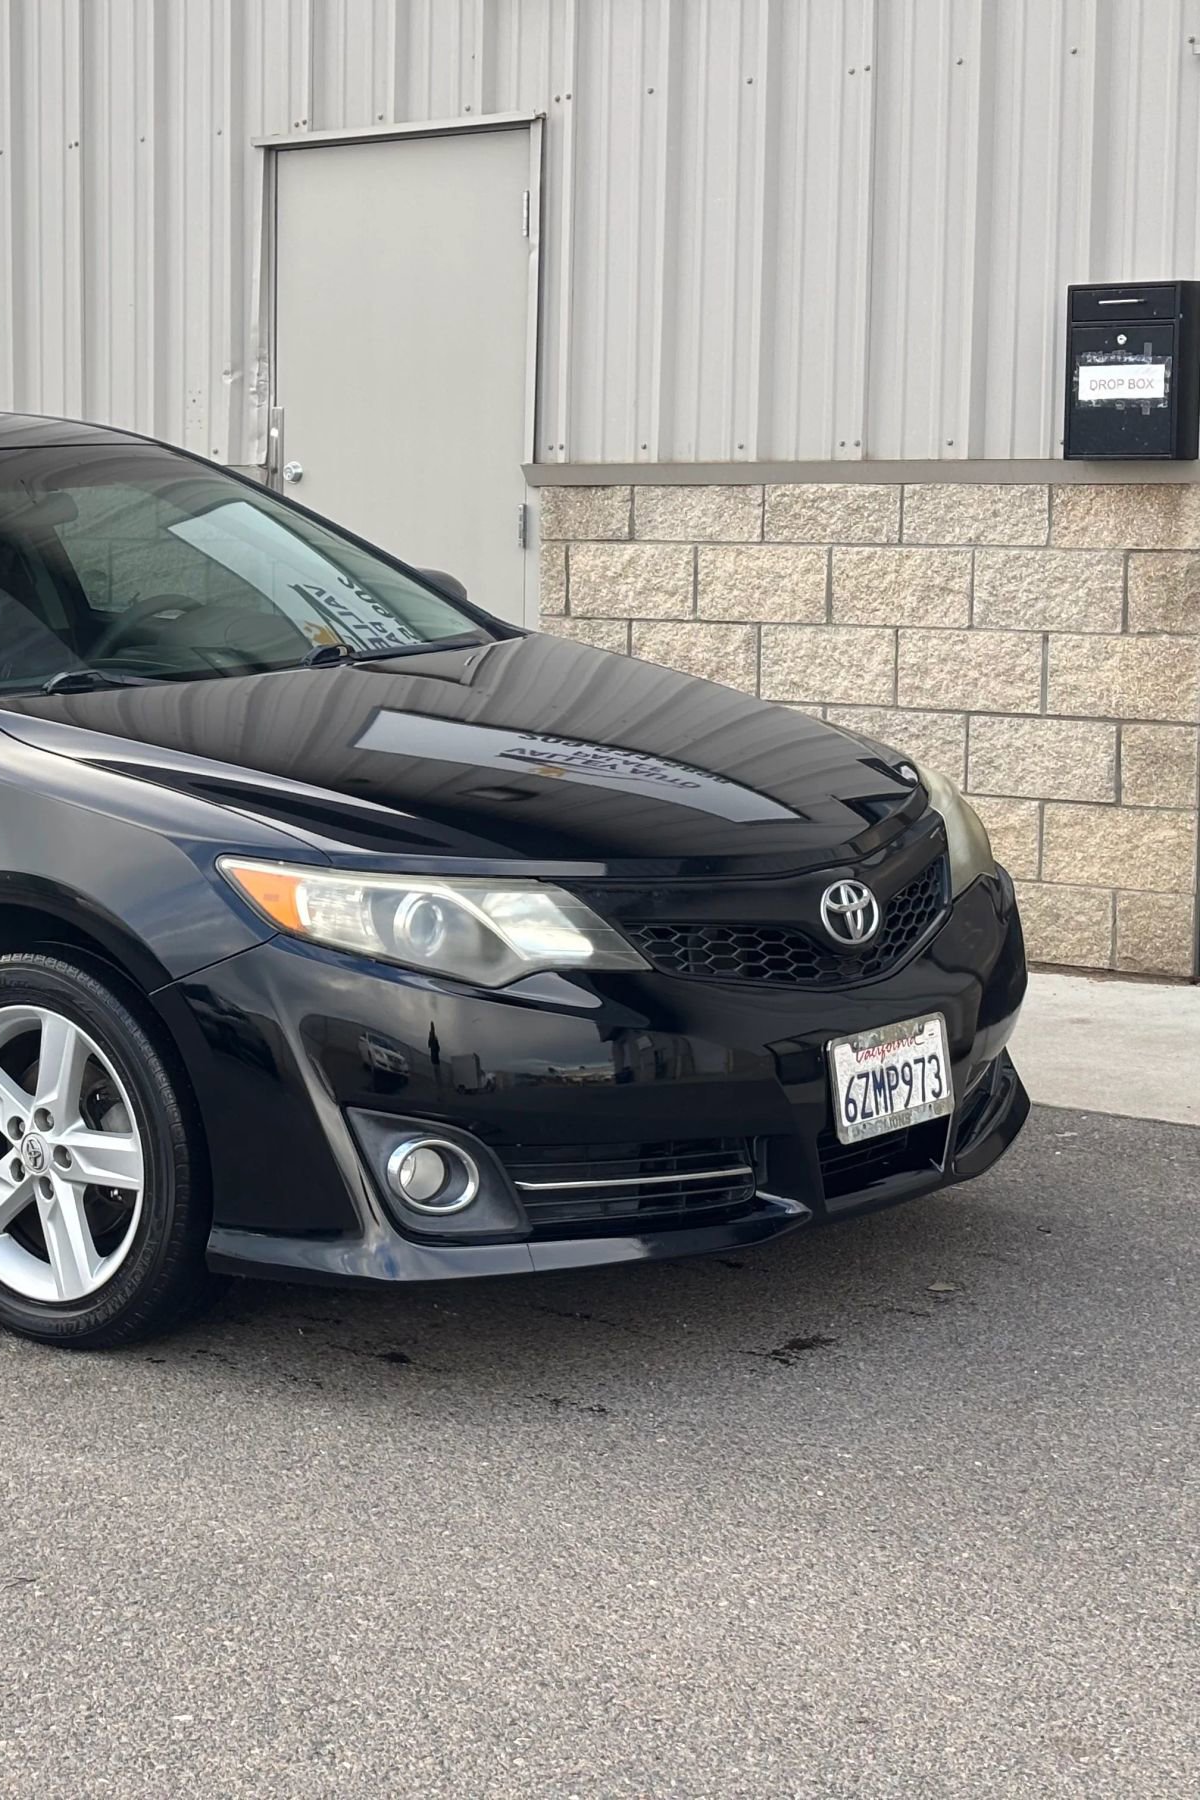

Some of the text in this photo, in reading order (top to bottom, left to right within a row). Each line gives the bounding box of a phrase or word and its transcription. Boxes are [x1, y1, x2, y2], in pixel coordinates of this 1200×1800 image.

[1090, 378, 1154, 391] DROP BOX
[844, 1054, 943, 1123] 6ZMP973
